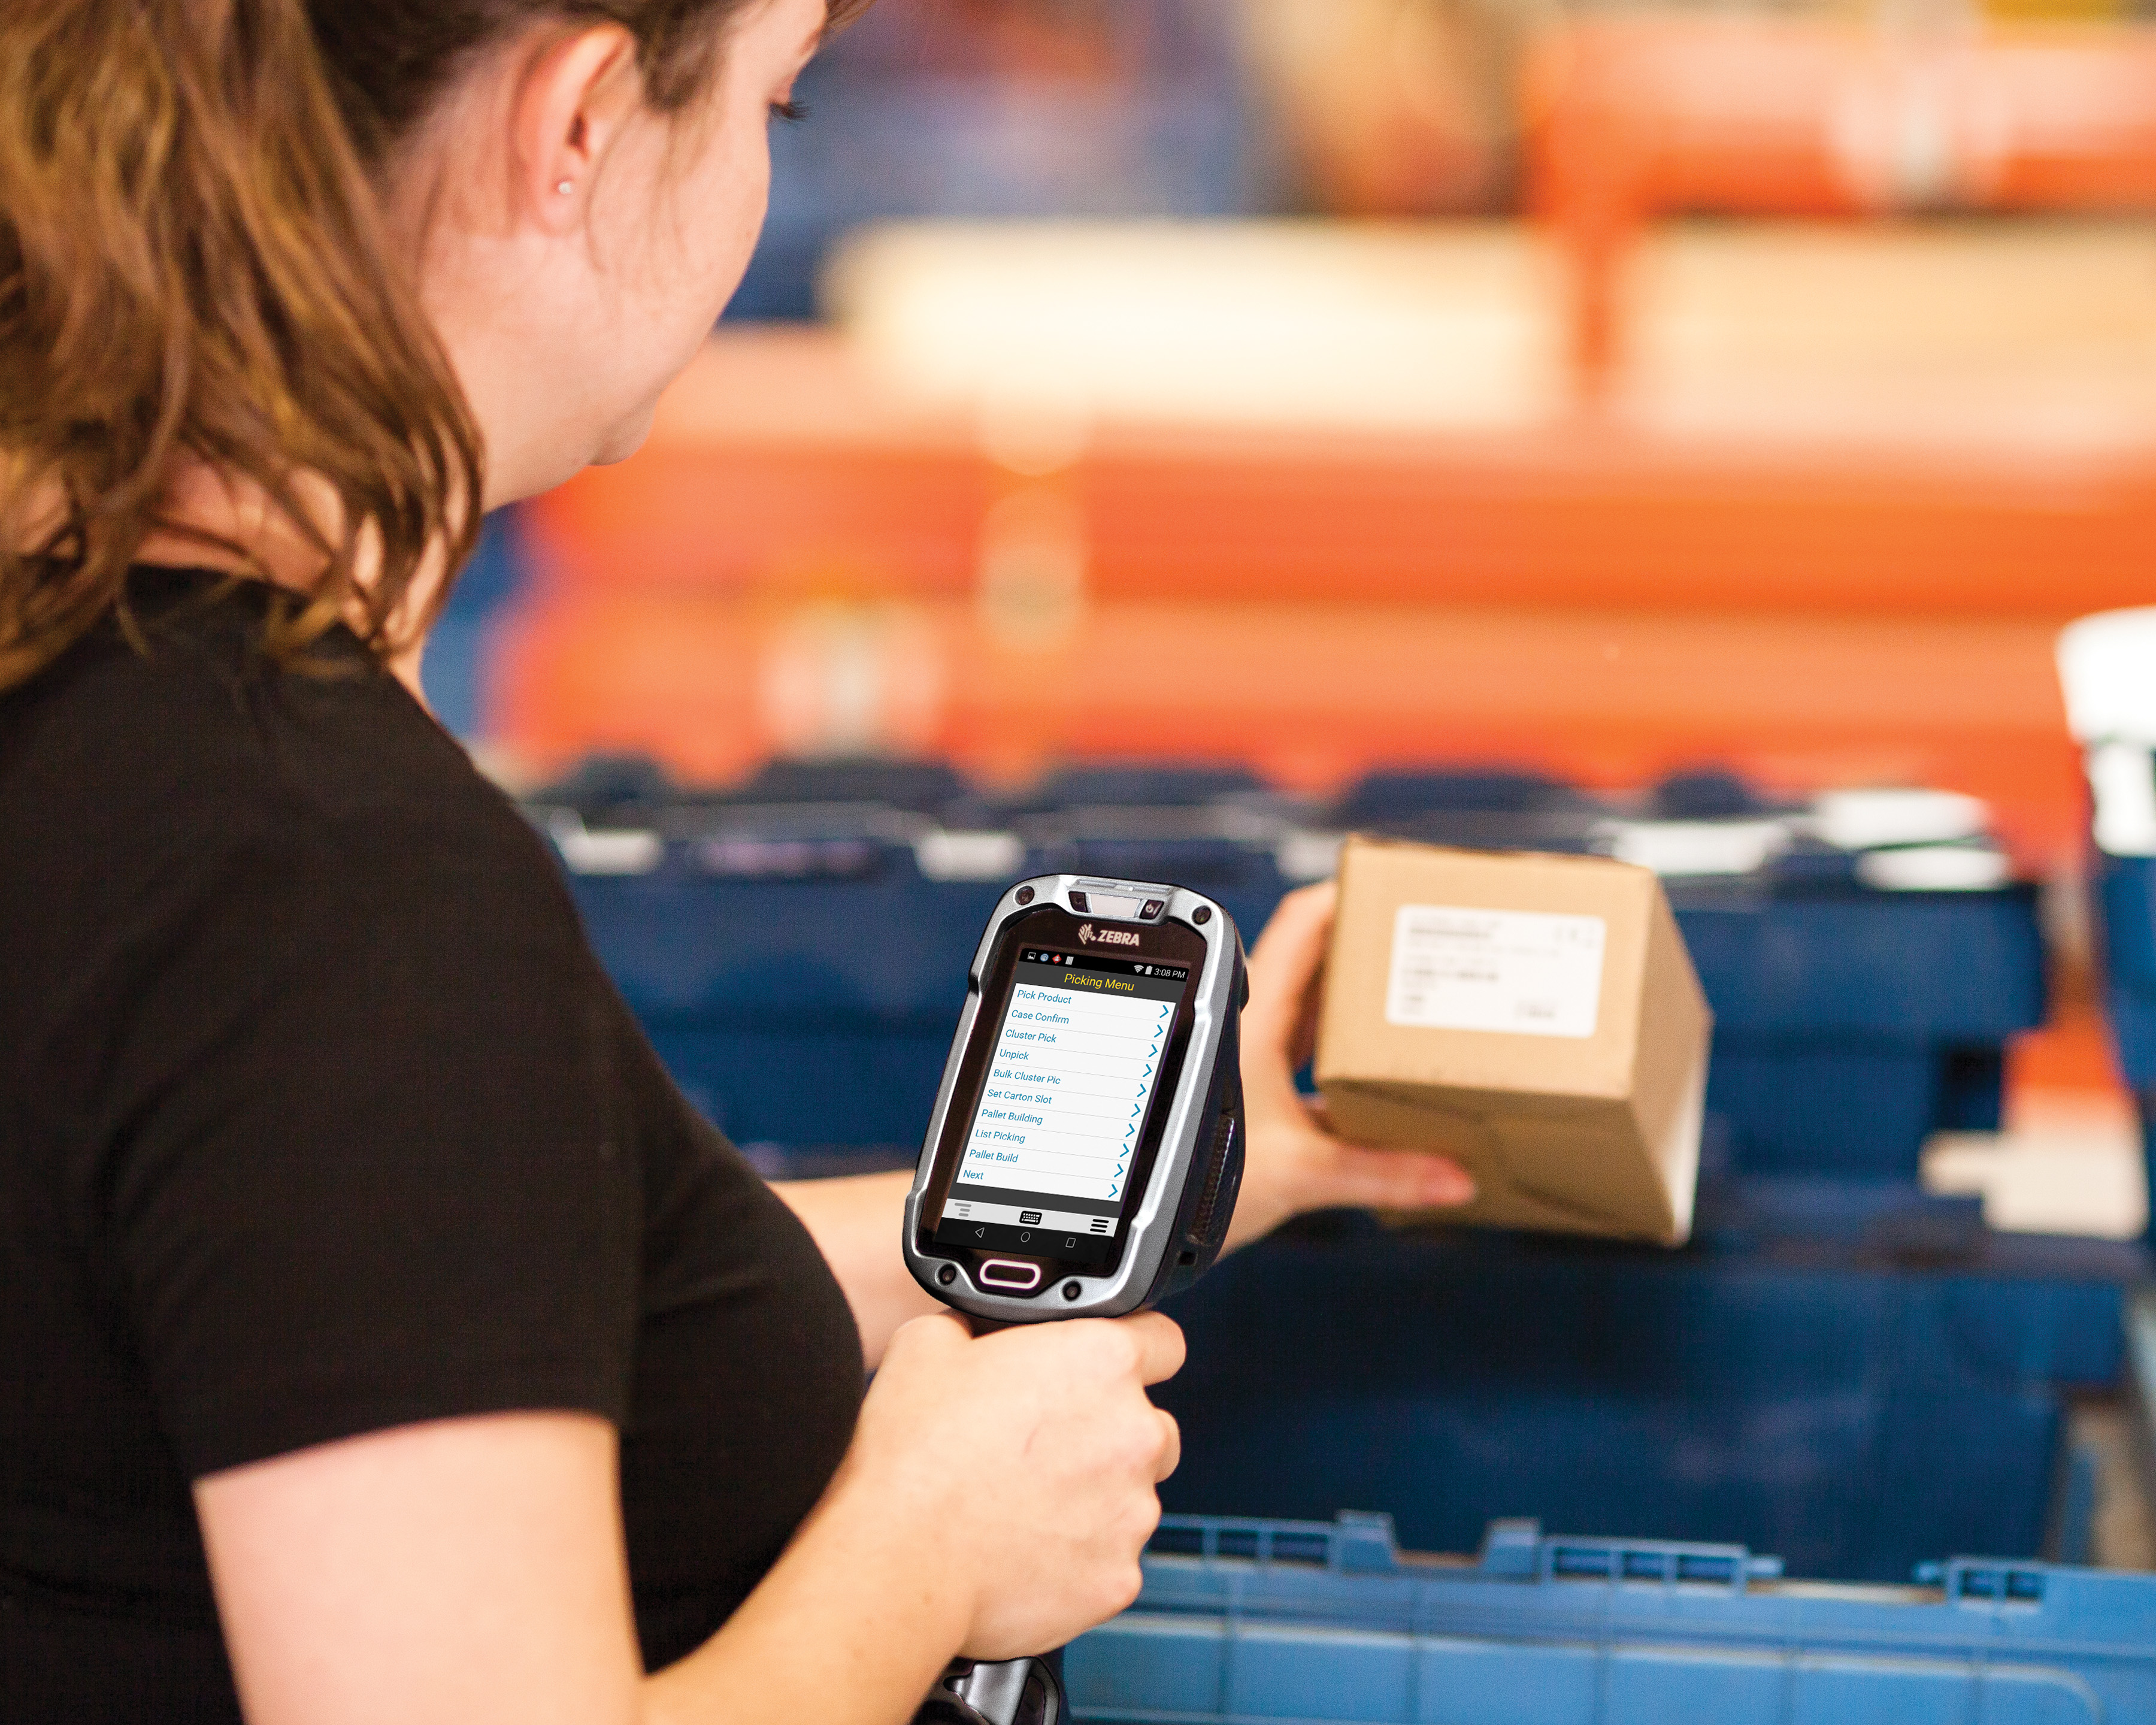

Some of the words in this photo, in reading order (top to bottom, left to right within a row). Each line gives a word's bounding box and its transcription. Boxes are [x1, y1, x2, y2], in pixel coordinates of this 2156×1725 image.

[1097, 930, 1140, 946] ZEBRA
[1153, 968, 1171, 978] 3:08
[1171, 970, 1186, 979] PM
[1064, 973, 1103, 989] Picking
[1104, 978, 1135, 991] Menu
[1017, 989, 1037, 1000] Pick
[1037, 992, 1072, 1004] Product
[1012, 1009, 1034, 1020] Case
[1035, 1012, 1070, 1024] Confirm
[1006, 1028, 1037, 1040] Cluster
[1037, 1033, 1057, 1043] Pick
[1000, 1049, 1029, 1061] Unpick
[993, 1069, 1013, 1079] Bulk
[1015, 1071, 1046, 1083] Cluster
[1046, 1075, 1061, 1085] Pic
[987, 1088, 1003, 1098] Set
[1004, 1091, 1033, 1102] Carton
[1034, 1094, 1052, 1104] Slot
[981, 1109, 1007, 1119] Pallet
[1008, 1112, 1043, 1126] Building
[975, 1129, 992, 1139] List
[993, 1131, 1026, 1145] Picking
[969, 1149, 995, 1160] Pallet
[996, 1152, 1019, 1163] Build
[963, 1169, 984, 1181] Next
